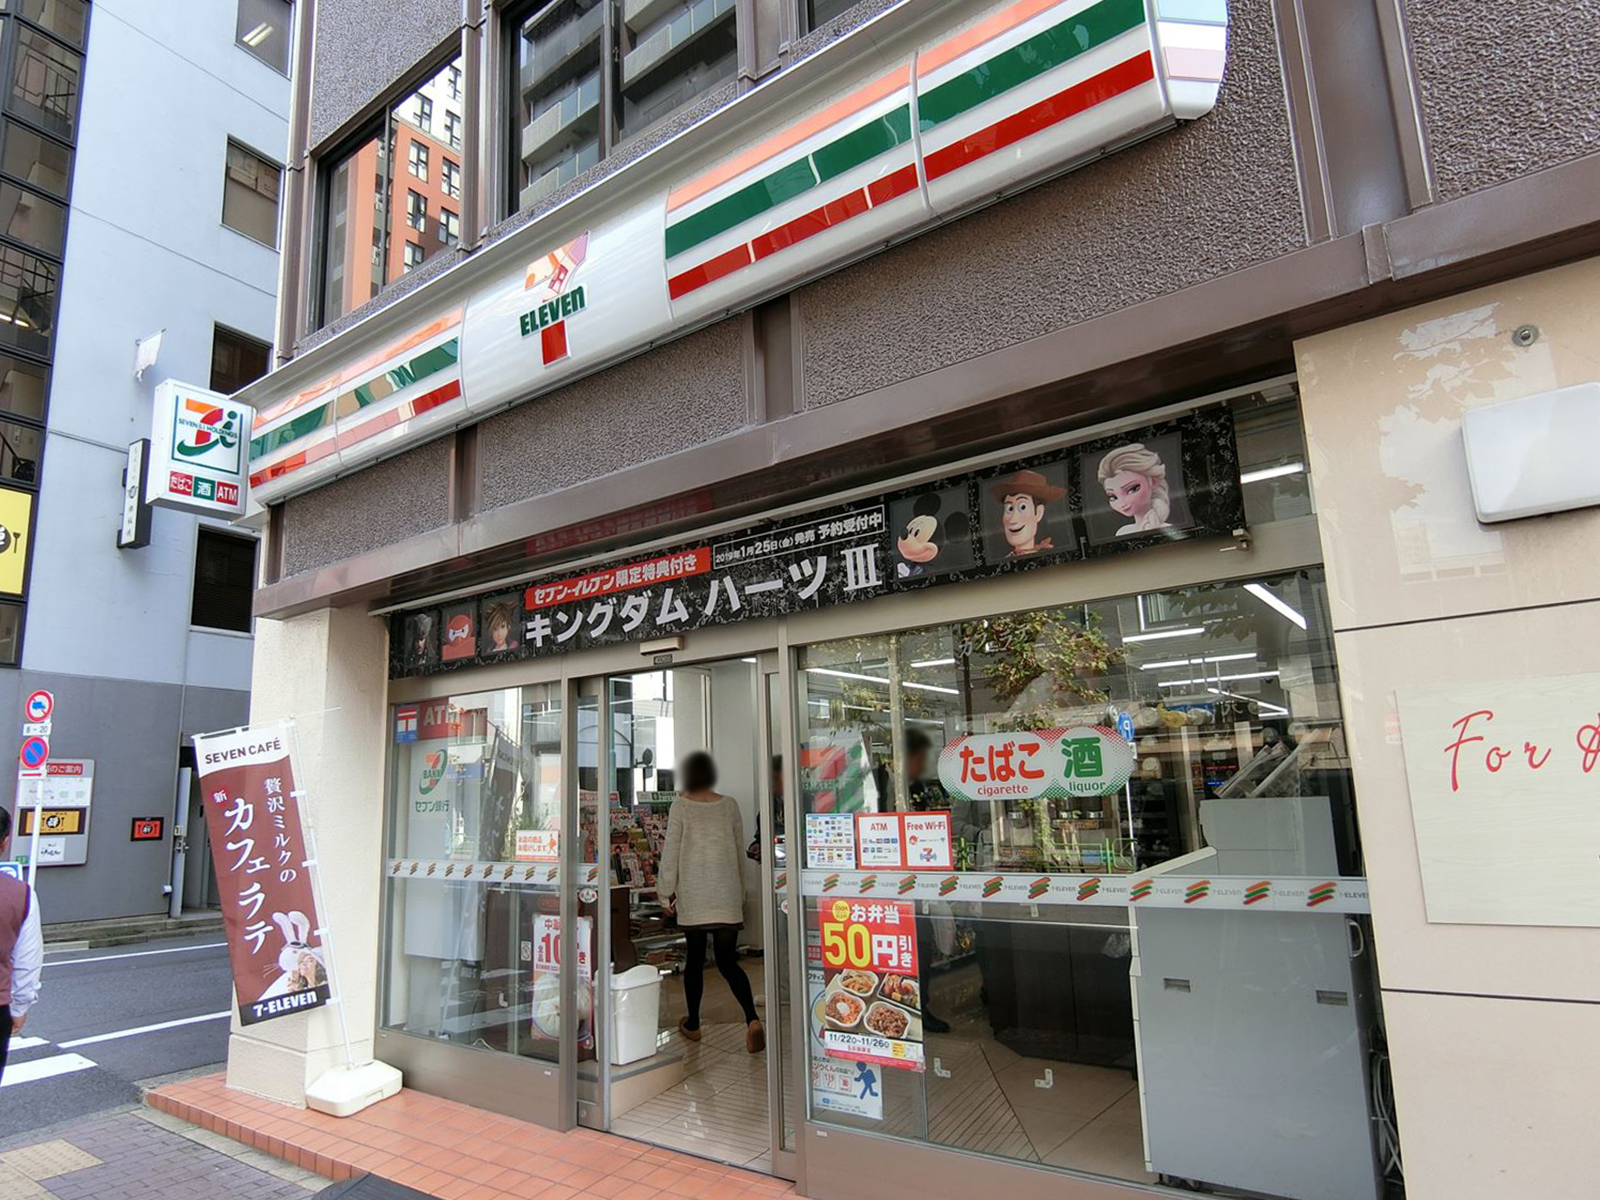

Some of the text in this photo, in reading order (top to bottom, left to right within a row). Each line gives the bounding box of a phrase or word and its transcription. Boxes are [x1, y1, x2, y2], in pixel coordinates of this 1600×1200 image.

[178, 417, 198, 428] SEVEN
[197, 481, 212, 497] 酒
[217, 485, 238, 501] ATM
[205, 737, 282, 764] SEVEN CAFÉ
[958, 736, 1104, 784] たばこ 酒
[1445, 709, 1552, 792] For
[213, 789, 228, 804] 新
[977, 781, 1107, 797] cigarette liquor
[264, 777, 297, 883] 贅沢ミルクの
[870, 822, 888, 831] ATM
[906, 822, 924, 831] Free
[223, 797, 274, 956] カフェラテ
[850, 903, 900, 925] お弁当
